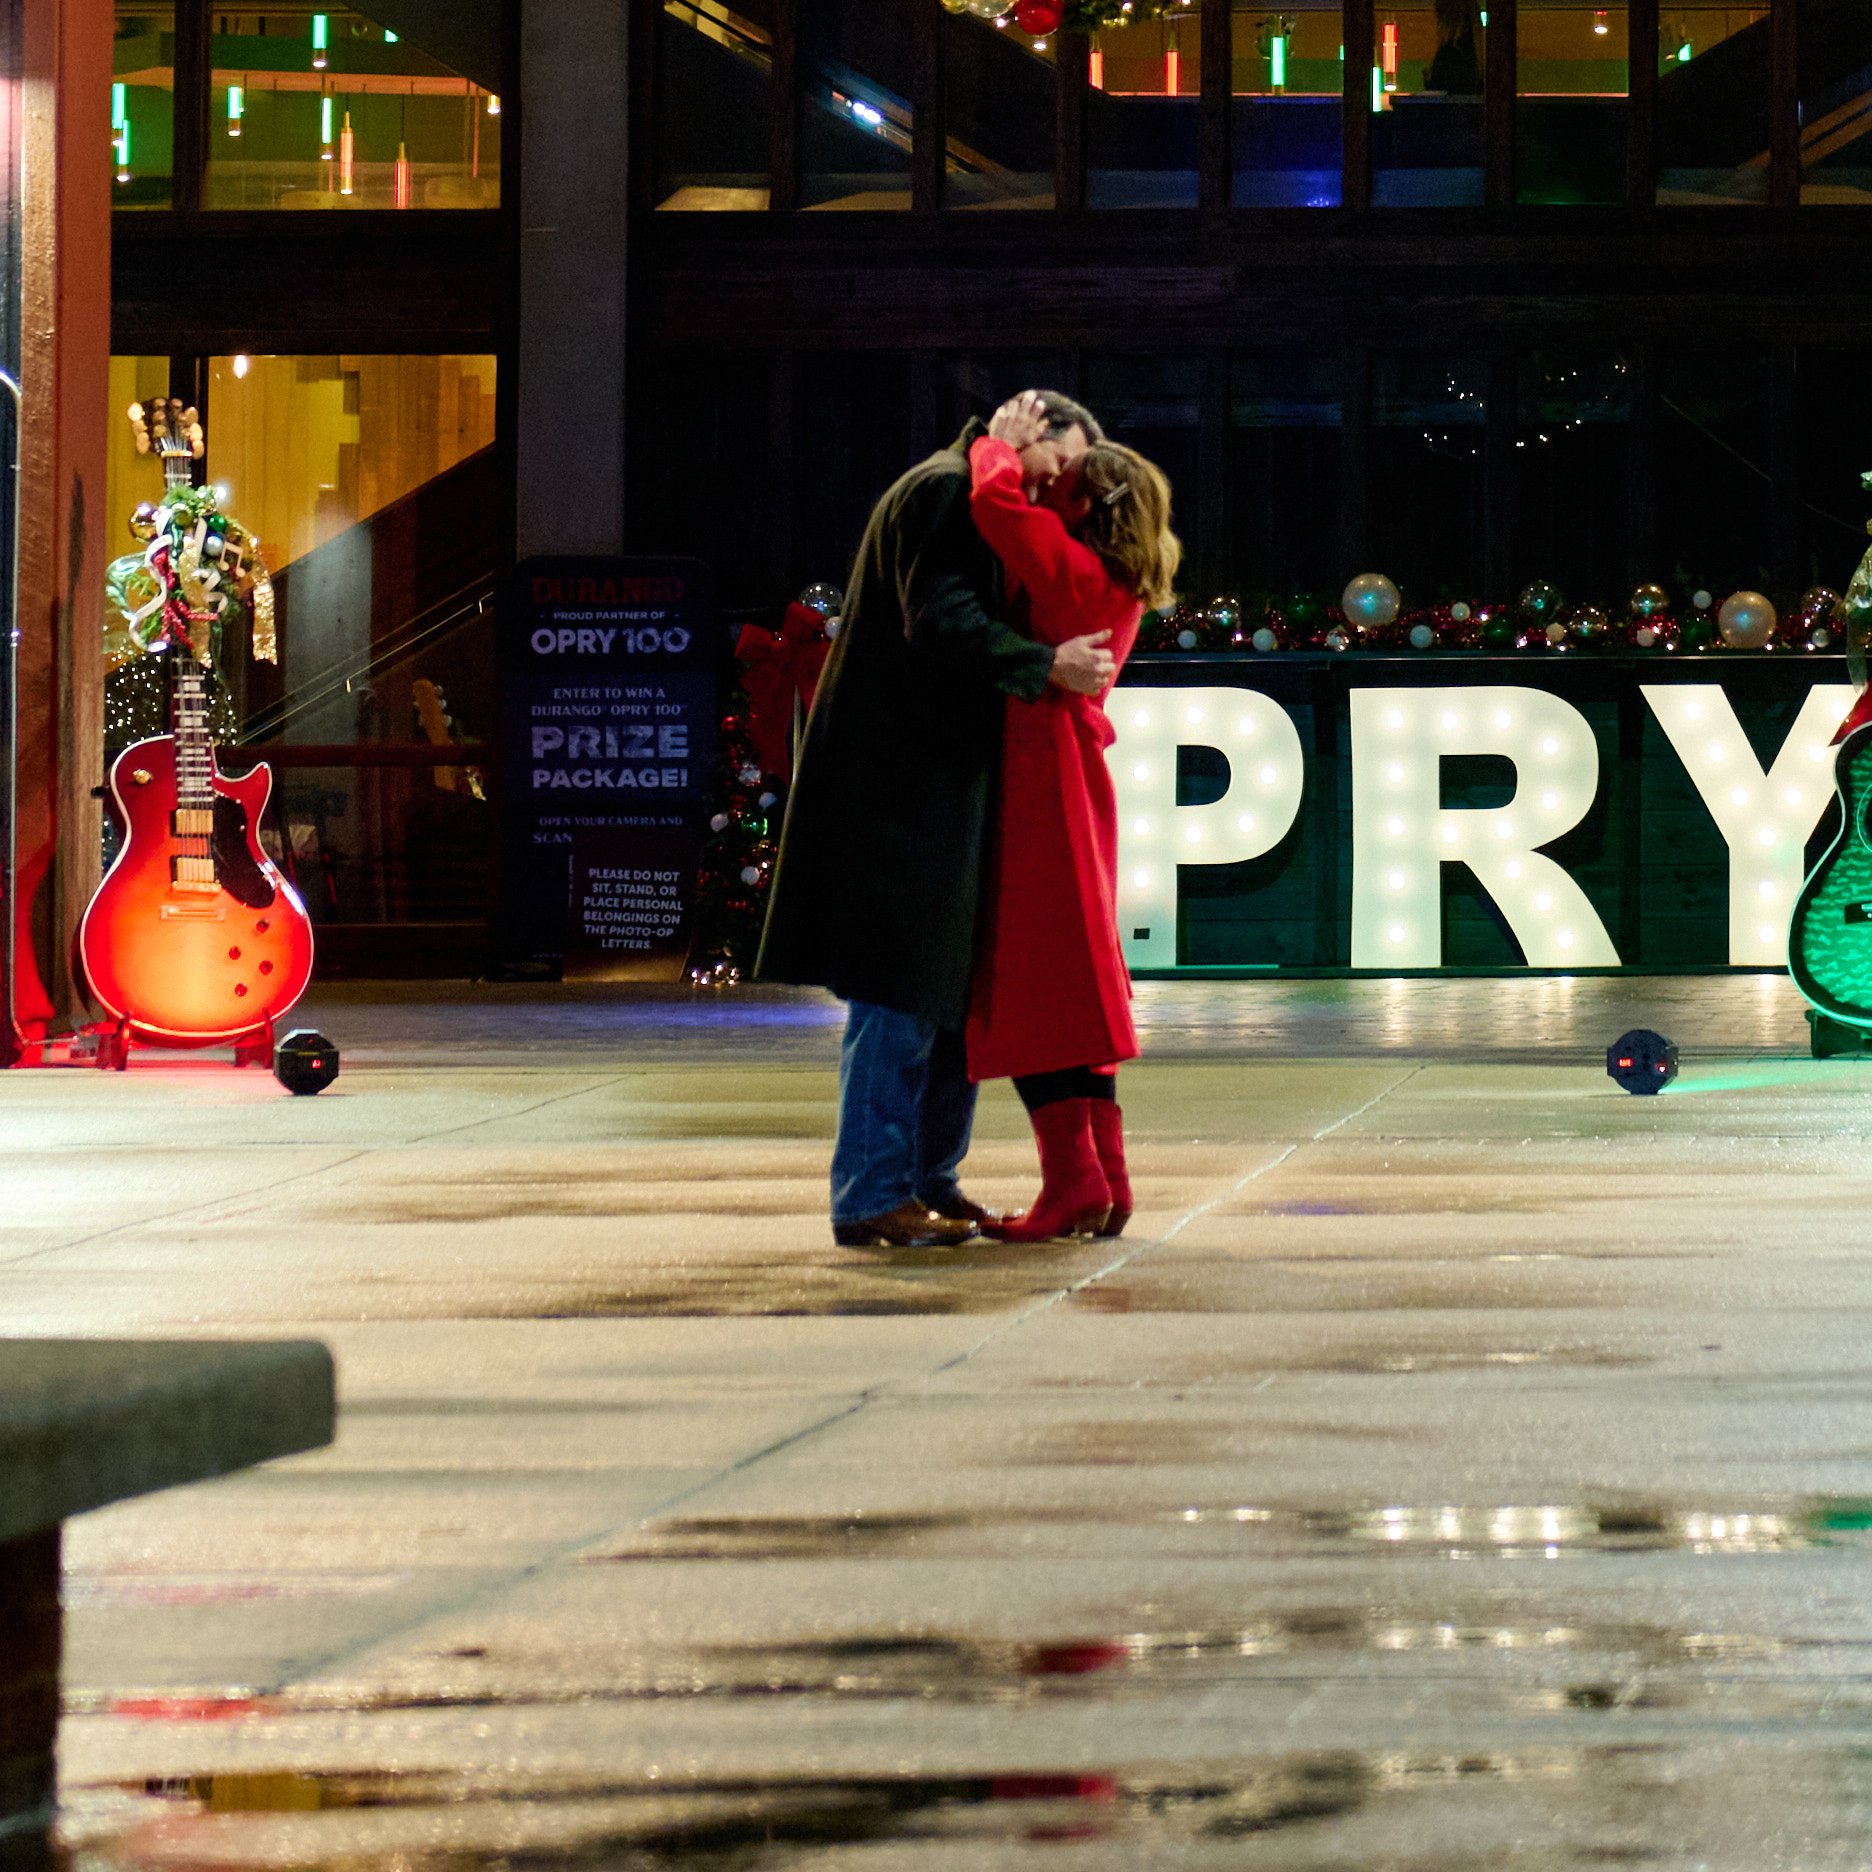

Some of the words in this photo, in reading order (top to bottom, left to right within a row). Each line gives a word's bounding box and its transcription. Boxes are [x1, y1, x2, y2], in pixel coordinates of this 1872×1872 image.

[531, 576, 685, 604] DURANGO
[553, 611, 593, 620] PROUD
[595, 610, 648, 620] PARTNER
[650, 610, 666, 619] OF
[530, 628, 617, 654] OPRY
[622, 626, 691, 654] 100
[553, 688, 600, 699] ENTER
[604, 688, 622, 699] TO
[625, 687, 653, 699] WIN
[655, 688, 666, 699] A
[610, 705, 650, 716] OPRY
[531, 725, 689, 759] PRIZE
[532, 768, 688, 788] PACKAGE!
[539, 817, 571, 826] OPEN
[574, 817, 605, 826] YOUR
[608, 816, 656, 826] CAMERA
[659, 816, 683, 825] AND
[1108, 684, 1863, 968] PRY
[532, 832, 573, 844] SCAN
[589, 868, 630, 880] PLEASE
[633, 870, 651, 880] DO
[654, 871, 680, 882] NOT
[592, 883, 612, 894] SIT,
[615, 884, 656, 896] STAND,
[659, 886, 677, 896] OR
[583, 896, 620, 908] PLACE
[622, 898, 684, 911] PERSONAL
[583, 911, 659, 924] BELONGINGS
[662, 914, 680, 925] ON
[584, 925, 606, 934] THE
[609, 925, 674, 938] PHOTO-OP
